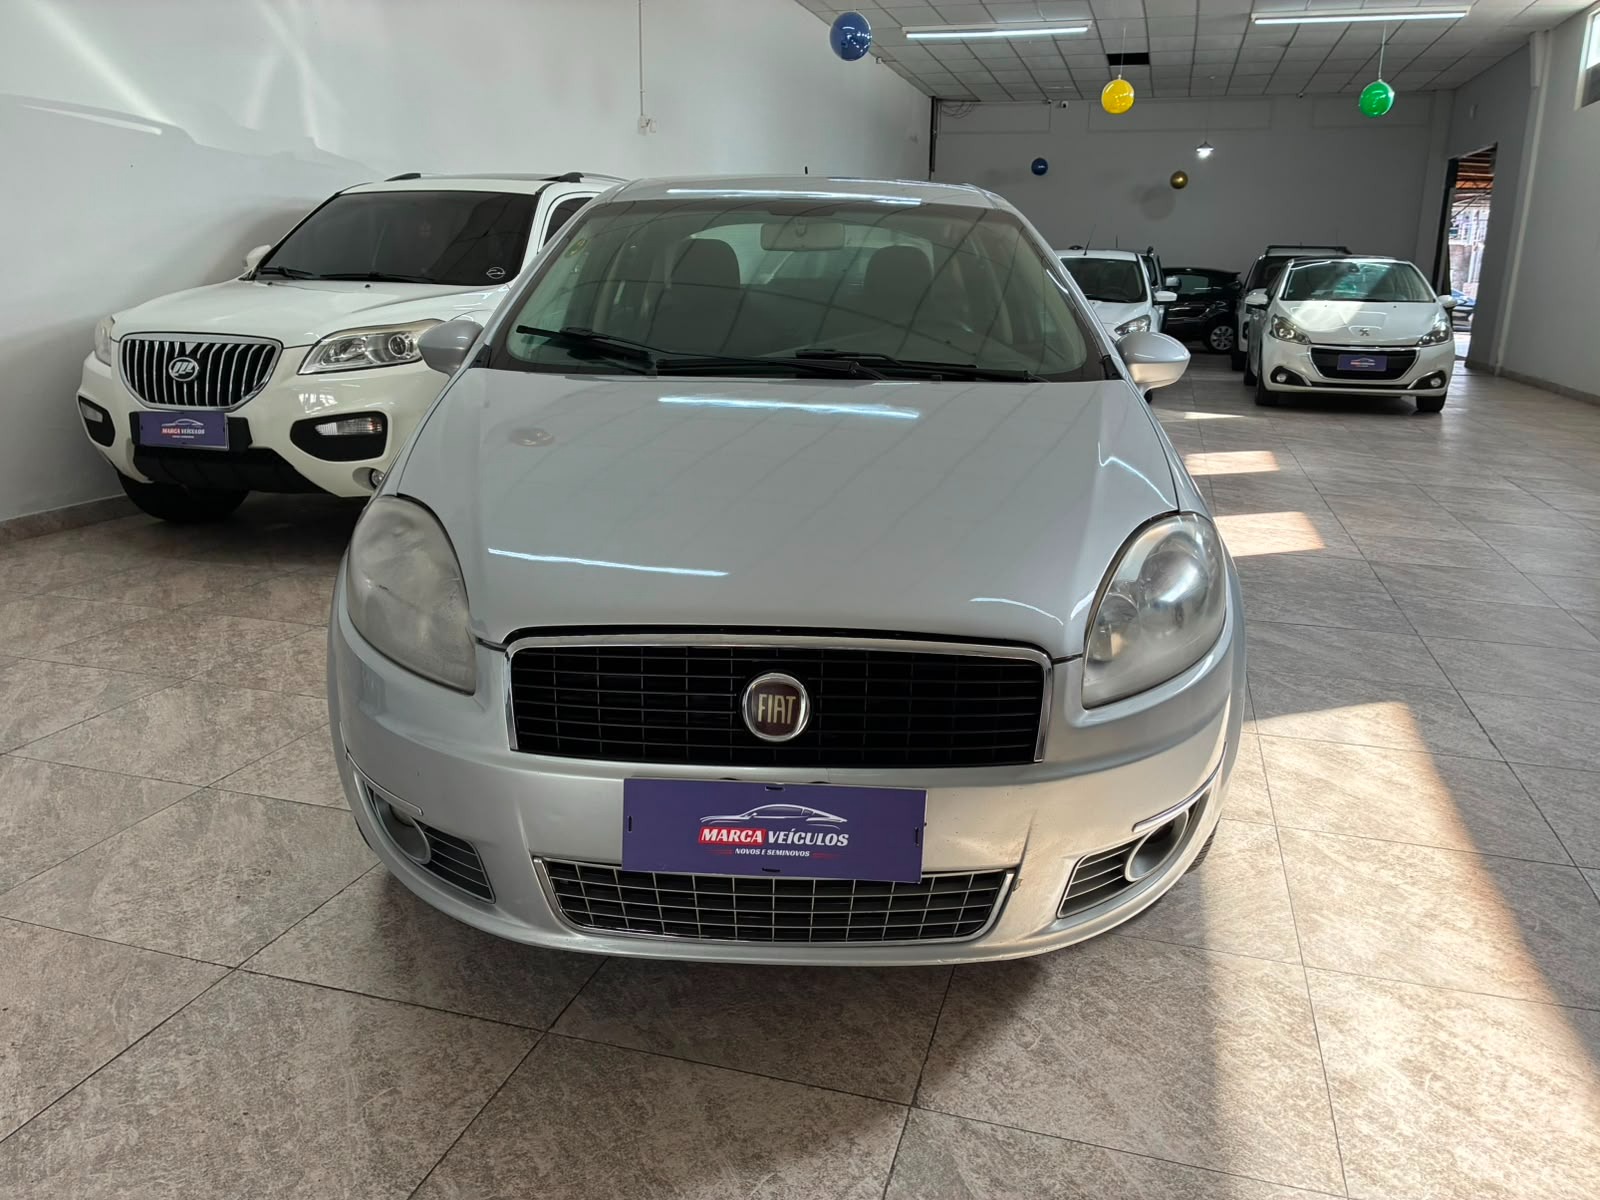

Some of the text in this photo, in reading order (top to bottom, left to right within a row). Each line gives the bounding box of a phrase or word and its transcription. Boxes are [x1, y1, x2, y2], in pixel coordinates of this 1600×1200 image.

[758, 693, 796, 724] FIAT
[701, 829, 849, 846] MARCA VEÍCULOS
[767, 849, 810, 857] SEMINOVOS
